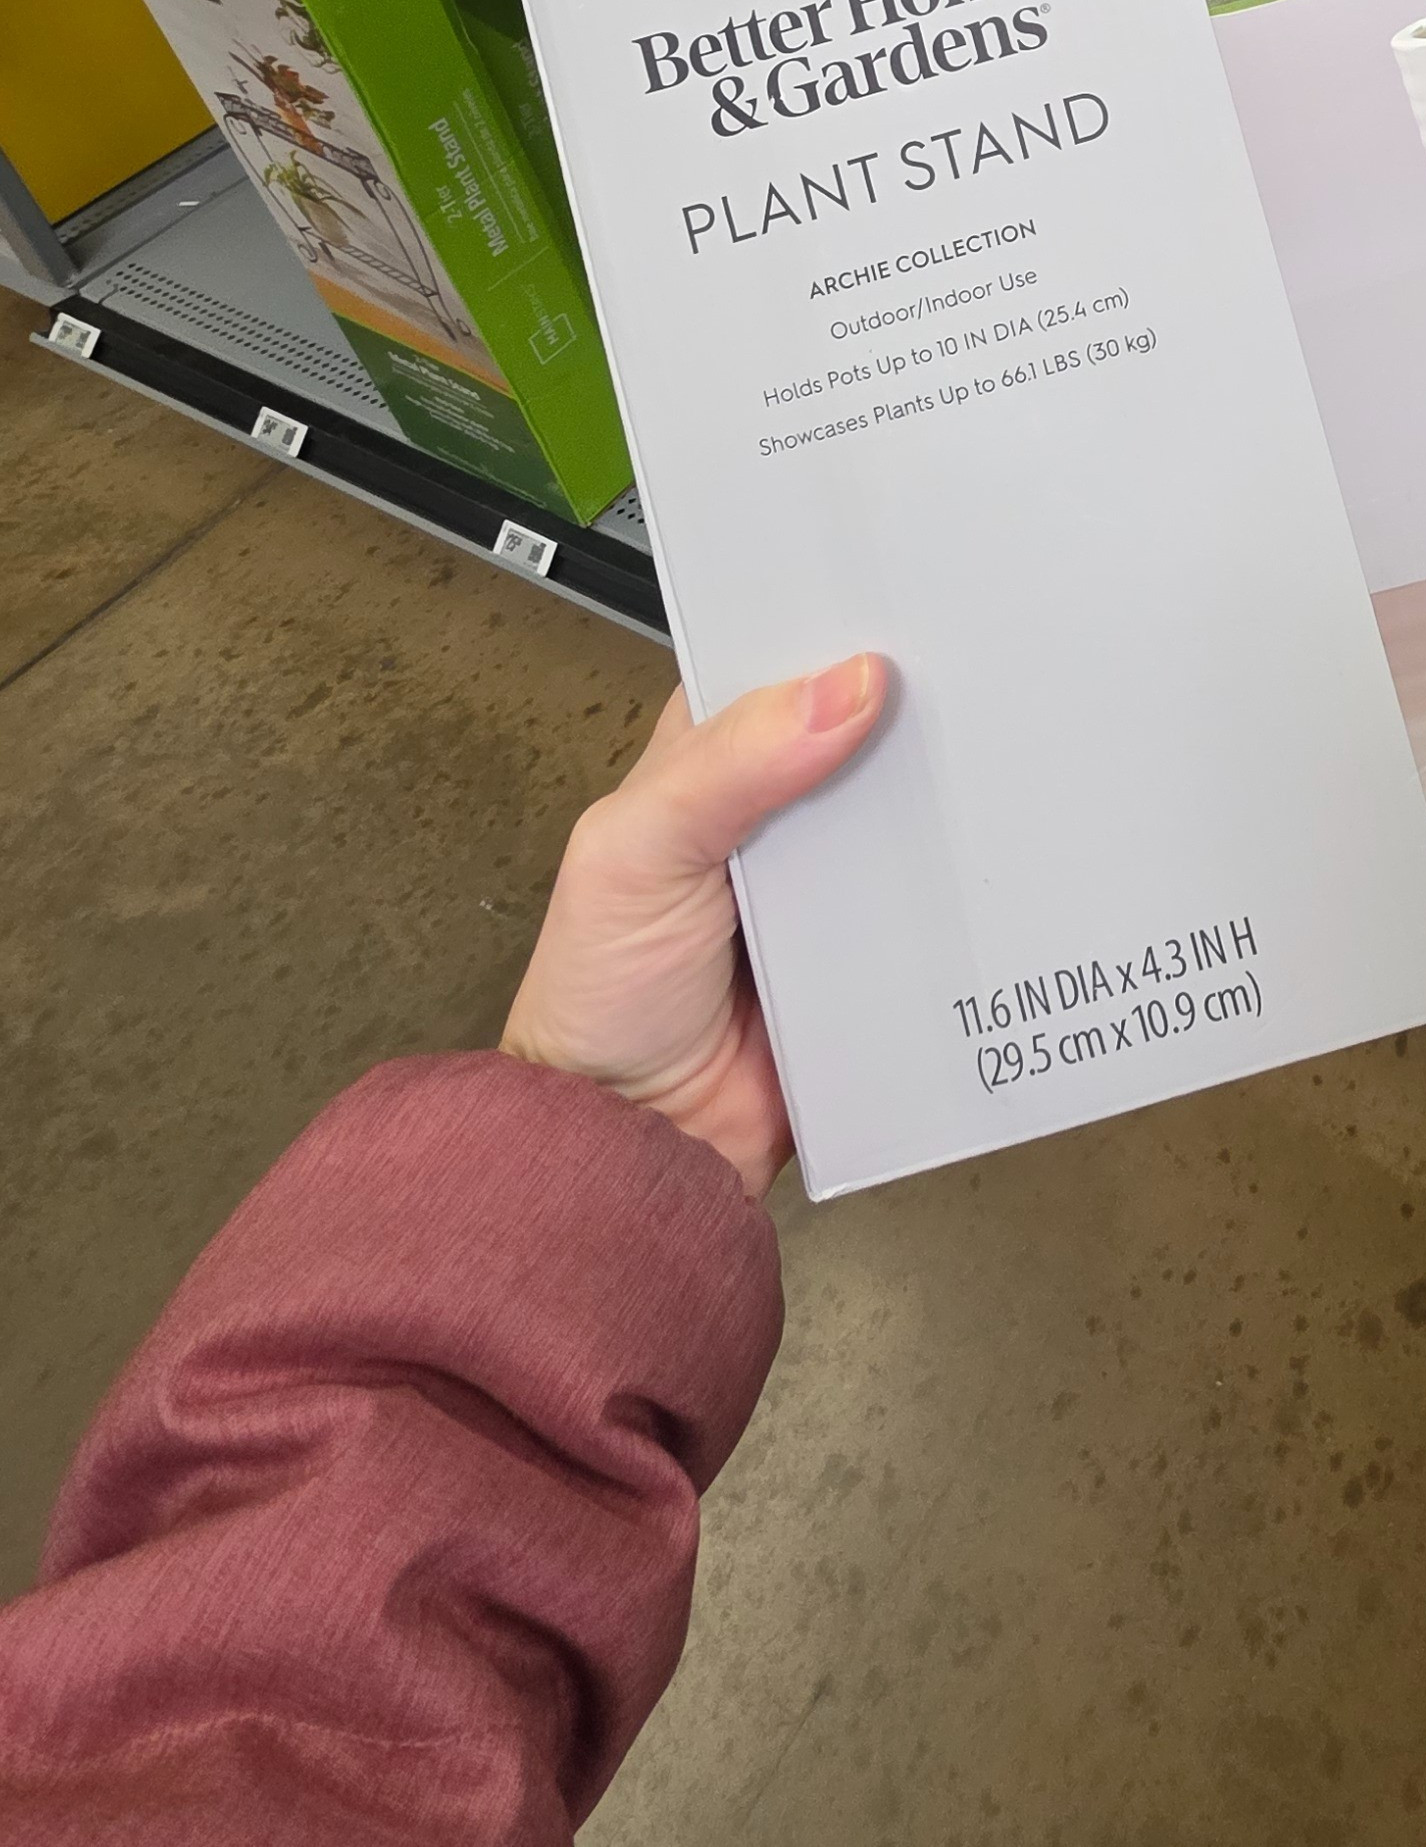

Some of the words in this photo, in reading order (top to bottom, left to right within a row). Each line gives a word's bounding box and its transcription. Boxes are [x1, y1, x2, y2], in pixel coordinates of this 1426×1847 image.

[427, 116, 466, 171] Stand
[681, 152, 879, 255] PLANT
[899, 92, 1109, 191] STAND
[435, 183, 463, 225] 2-Tier
[453, 166, 487, 214] Plant
[481, 207, 510, 258] Metal
[809, 260, 892, 300] ARCHIE
[895, 219, 1037, 273] COLLECTION
[830, 282, 993, 339] Outdoor/Indoor
[999, 271, 1038, 291] Use
[763, 378, 823, 408] Holds
[827, 364, 872, 389] Pots
[876, 355, 906, 375] Up
[911, 348, 933, 365] to
[936, 336, 958, 357] 10
[963, 328, 987, 350] IN
[993, 317, 1033, 342] DIA
[1037, 301, 1087, 332] (25.4
[1092, 287, 1129, 313] cm)
[759, 413, 869, 456] Showcases
[873, 395, 934, 424] Plants
[939, 385, 969, 405] Up
[973, 378, 996, 395] to
[1001, 362, 1038, 388] 66.1
[1042, 350, 1081, 376] LBS
[1087, 338, 1120, 366] (30
[1125, 327, 1157, 353] kg)
[952, 988, 1012, 1038] 11.6
[1014, 975, 1052, 1023] IN
[1054, 959, 1115, 1011] DIA
[1115, 961, 1140, 994] x
[1141, 938, 1188, 984] 4.3
[1189, 924, 1228, 971] IN
[1229, 916, 1259, 960] H
[976, 1032, 1052, 1094] (29.5
[1058, 1026, 1107, 1065] cm
[1109, 1018, 1133, 1051] x
[1131, 991, 1196, 1043] 10.9
[1204, 970, 1263, 1023] cm)
